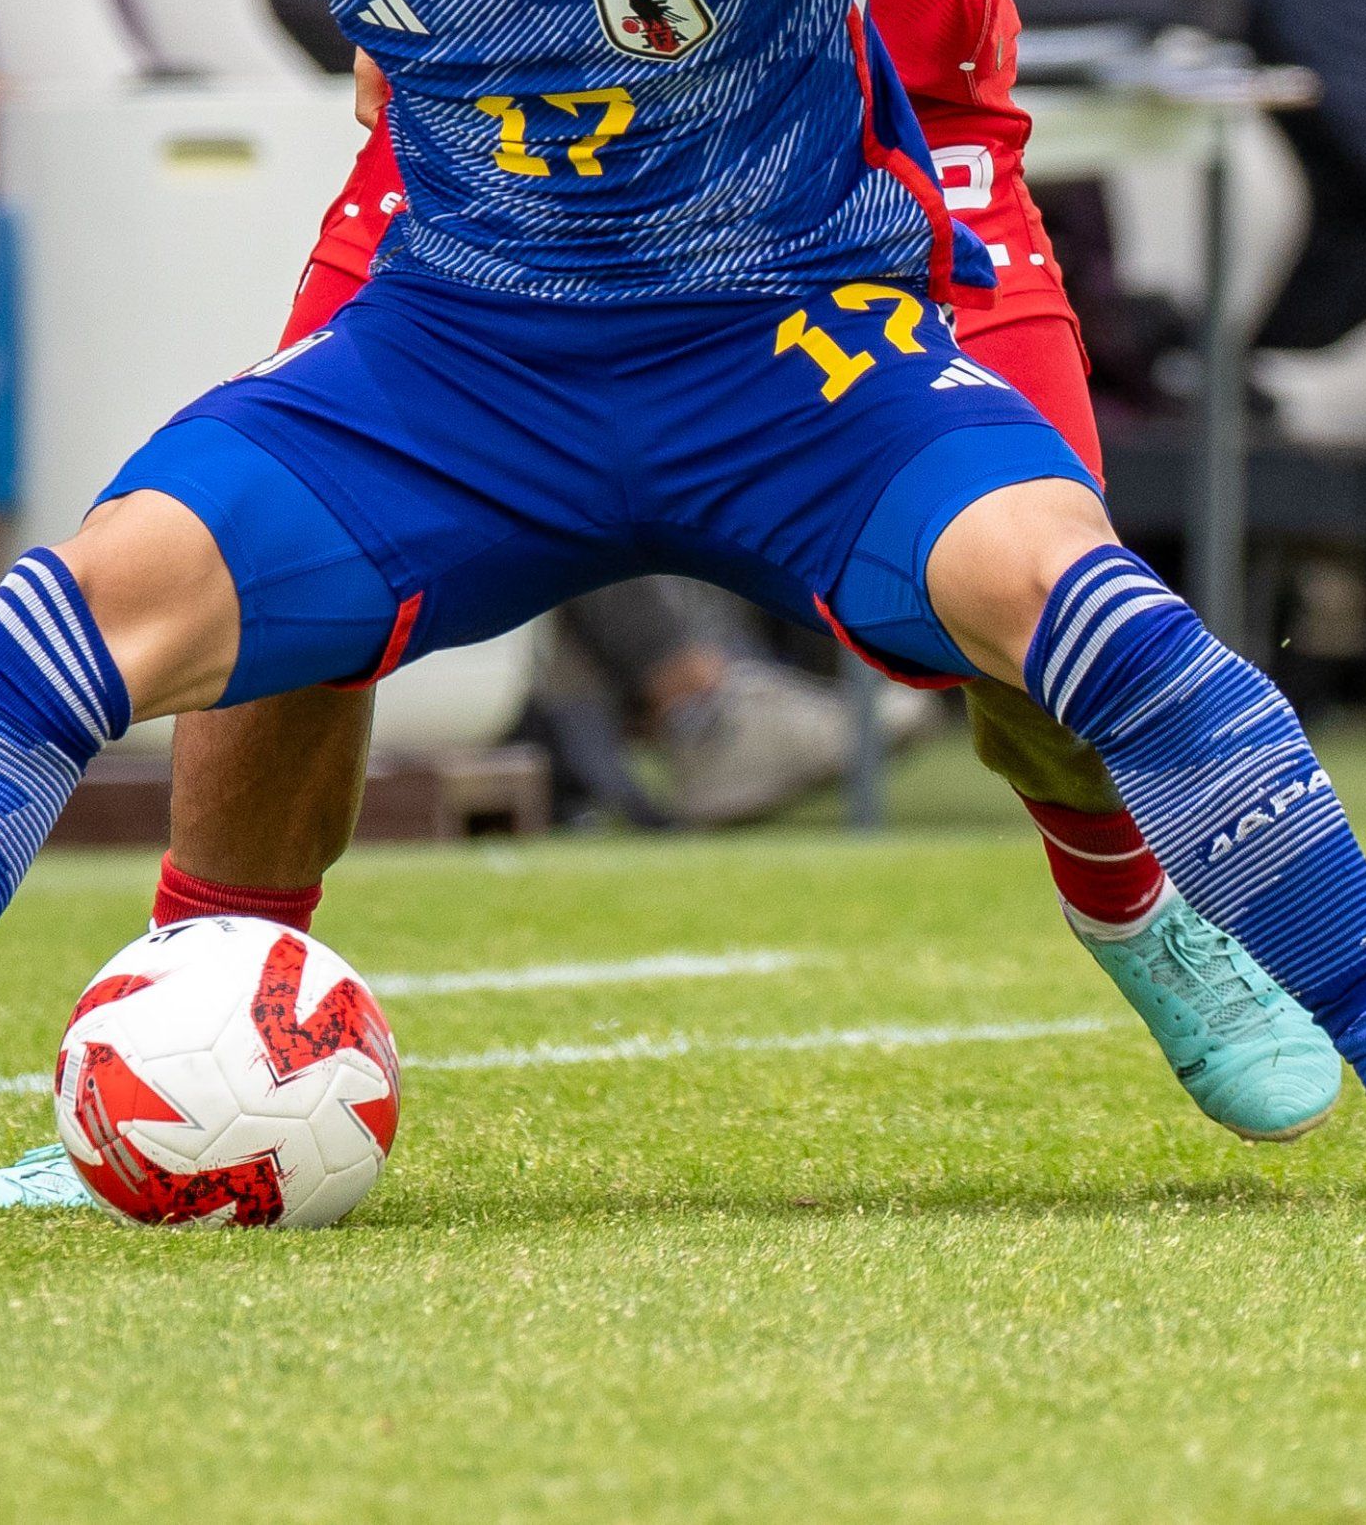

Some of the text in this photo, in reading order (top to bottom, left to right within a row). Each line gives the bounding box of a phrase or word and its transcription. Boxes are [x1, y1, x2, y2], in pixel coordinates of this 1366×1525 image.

[475, 87, 636, 177] 17
[774, 283, 927, 403] 17
[1208, 768, 1332, 863] JAPA
